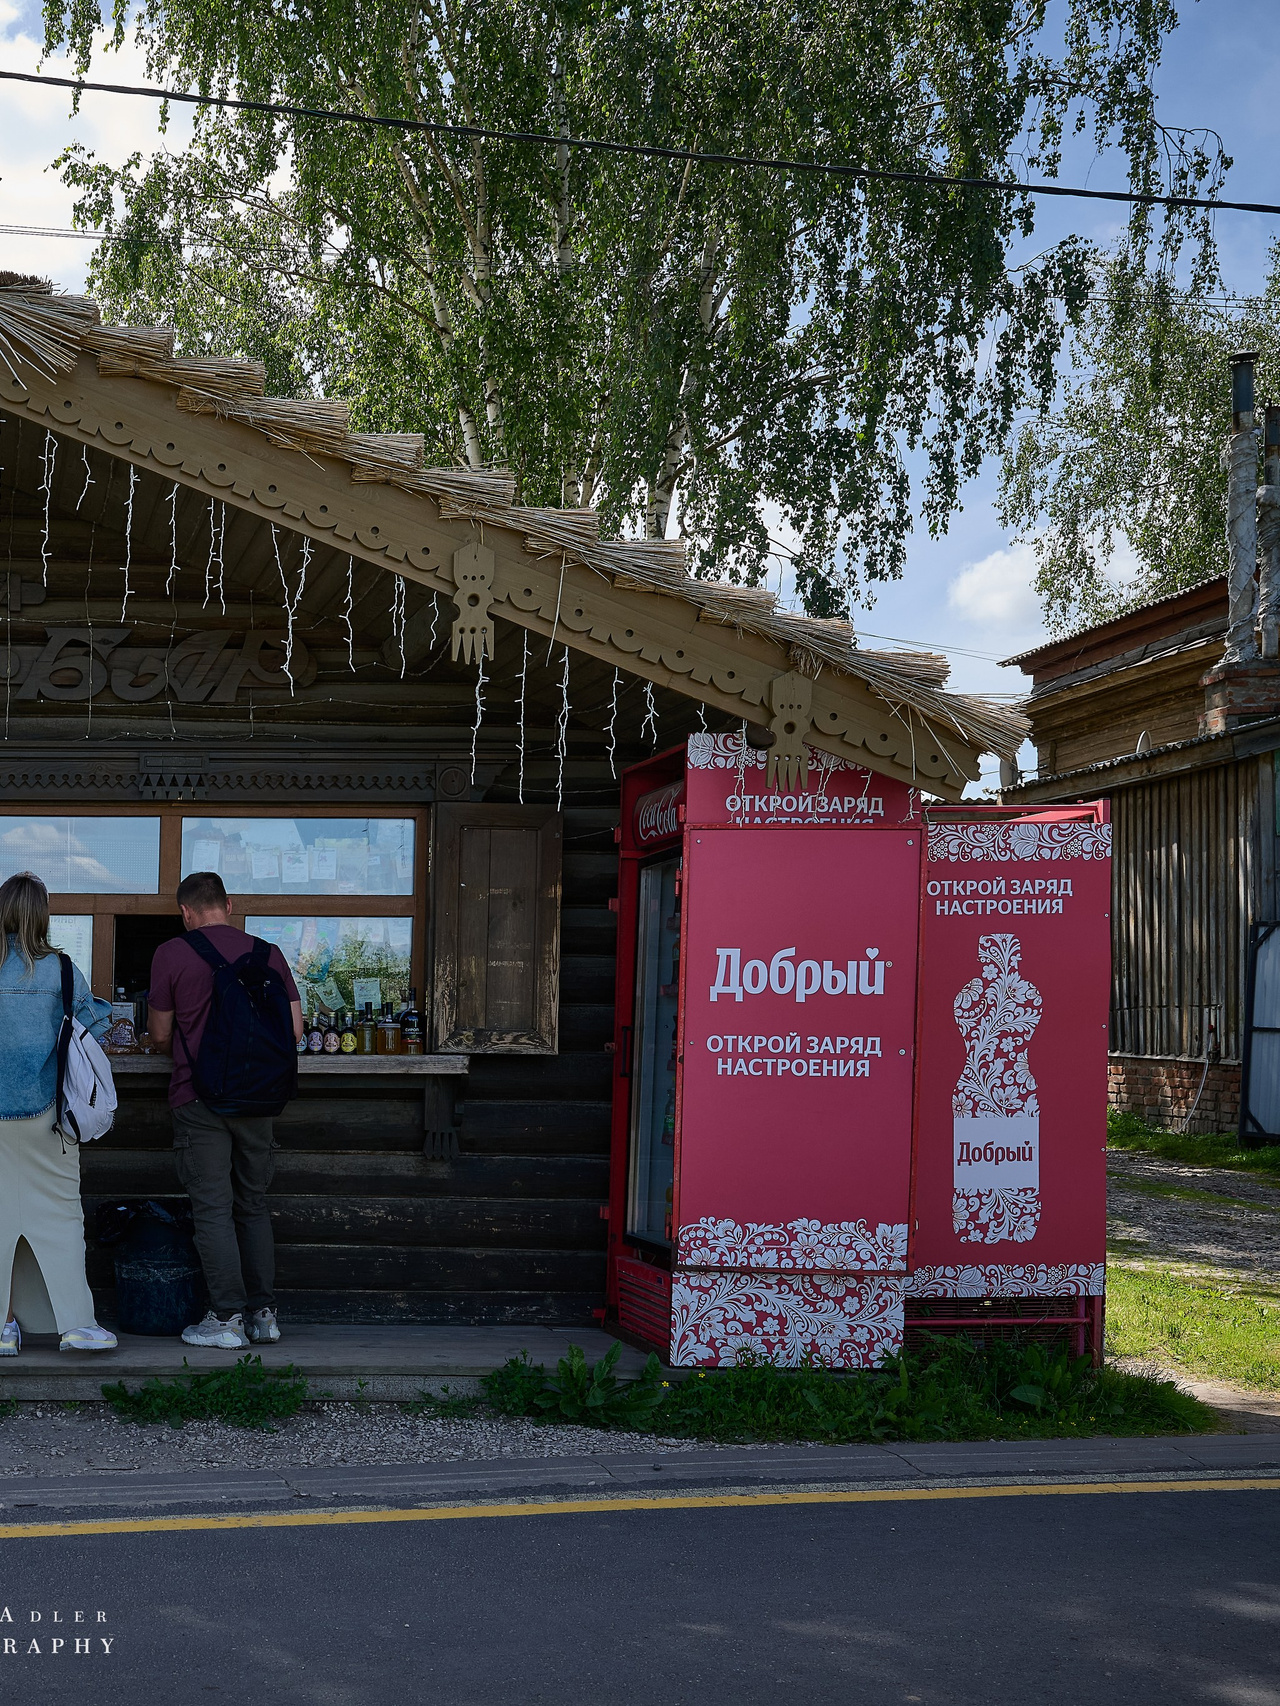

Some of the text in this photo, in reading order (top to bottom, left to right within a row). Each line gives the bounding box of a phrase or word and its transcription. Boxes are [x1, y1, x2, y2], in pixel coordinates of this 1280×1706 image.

[725, 792, 884, 816] ОТКРОЙ ЗАРЯД
[927, 877, 1073, 897] ОТКРОЙ ЗАРЯД
[936, 899, 1063, 915] НАСТРОЕНИЯ
[710, 946, 885, 1003] Добрый
[706, 1032, 882, 1057] ОТКРОЙ ЗАРЯД
[717, 1058, 870, 1077] НАСТРОЕНИЯ
[957, 1140, 1033, 1166] Добрый
